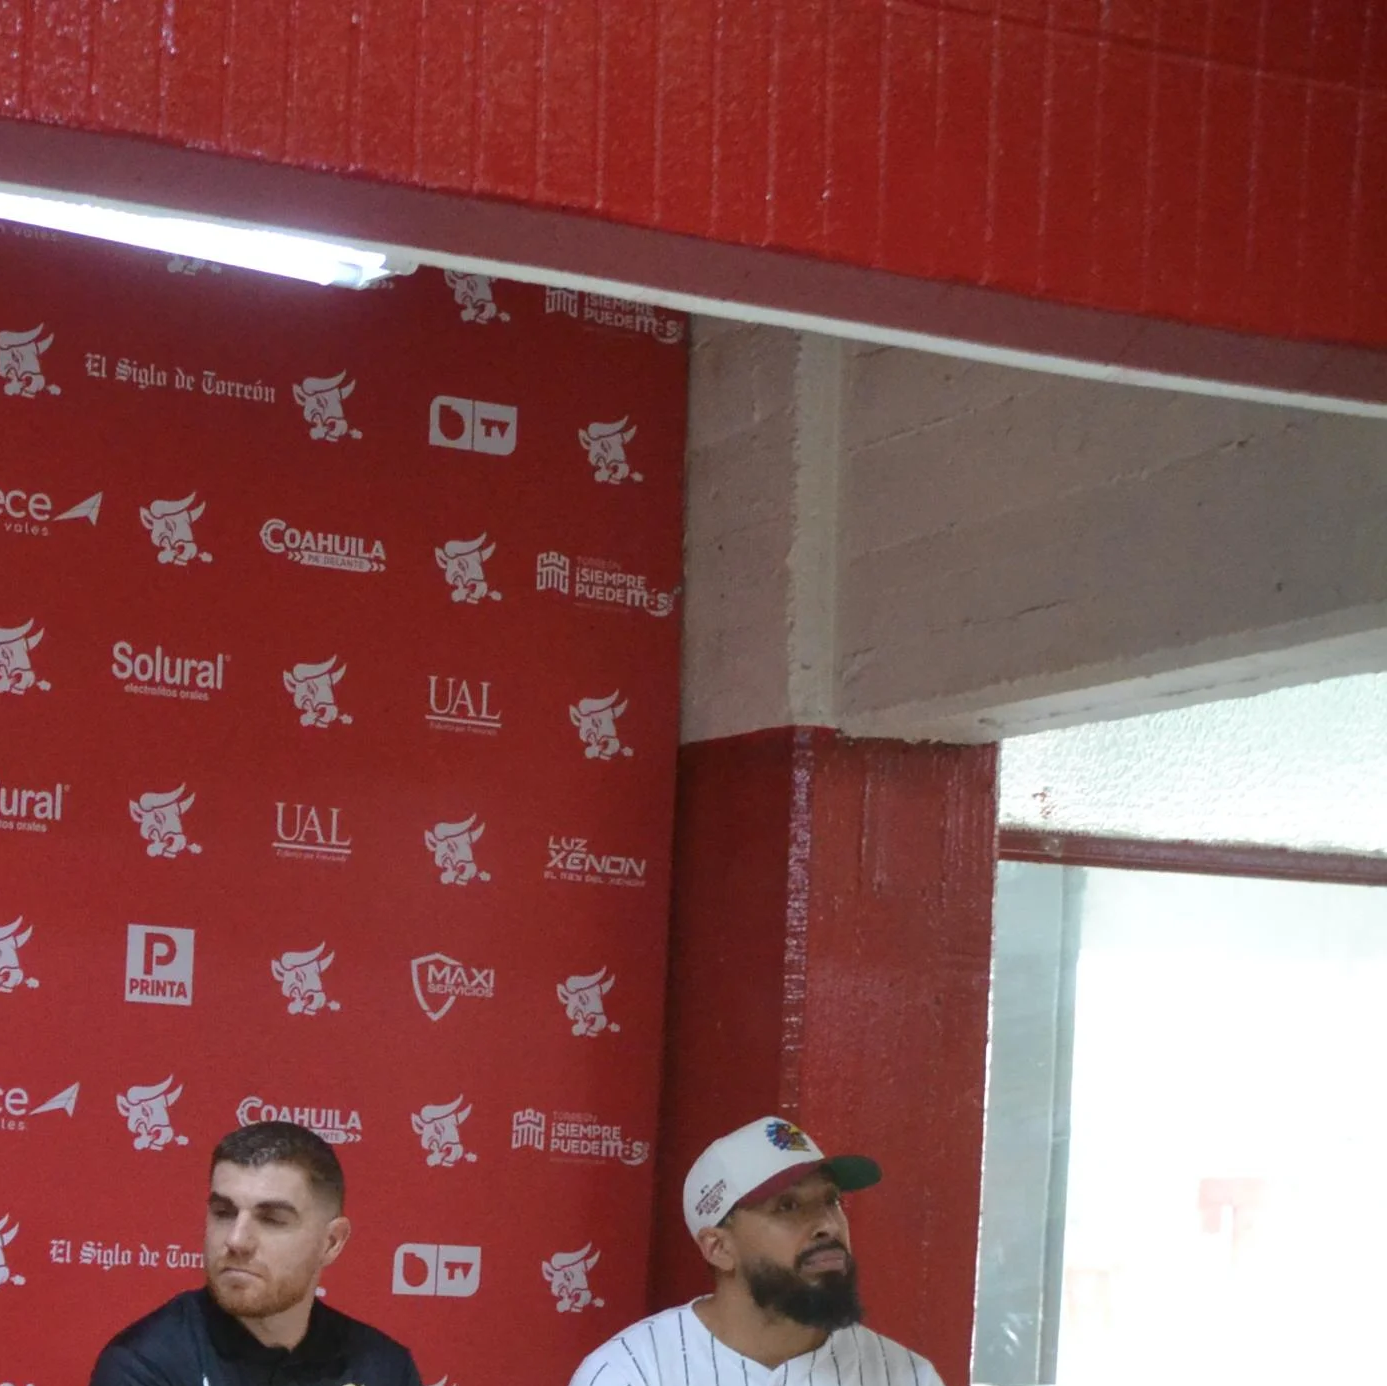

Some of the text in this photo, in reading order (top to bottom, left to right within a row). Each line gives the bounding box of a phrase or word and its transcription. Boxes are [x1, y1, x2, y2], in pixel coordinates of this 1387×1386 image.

[85, 352, 276, 404] El Siglo de Torreón
[4, 519, 51, 537] vales
[259, 517, 387, 564] COAHUILA
[111, 640, 224, 690] Solural
[427, 674, 502, 719] UAL
[275, 801, 353, 846] UAL
[548, 835, 587, 851] LUZ
[546, 849, 647, 877] XENON
[129, 978, 188, 999] PRINTA
[427, 963, 495, 988] MAXI
[427, 982, 494, 999] SERVICIOS
[49, 1239, 72, 1264] El
[79, 1240, 131, 1272] Siglo
[139, 1243, 159, 1268] de
